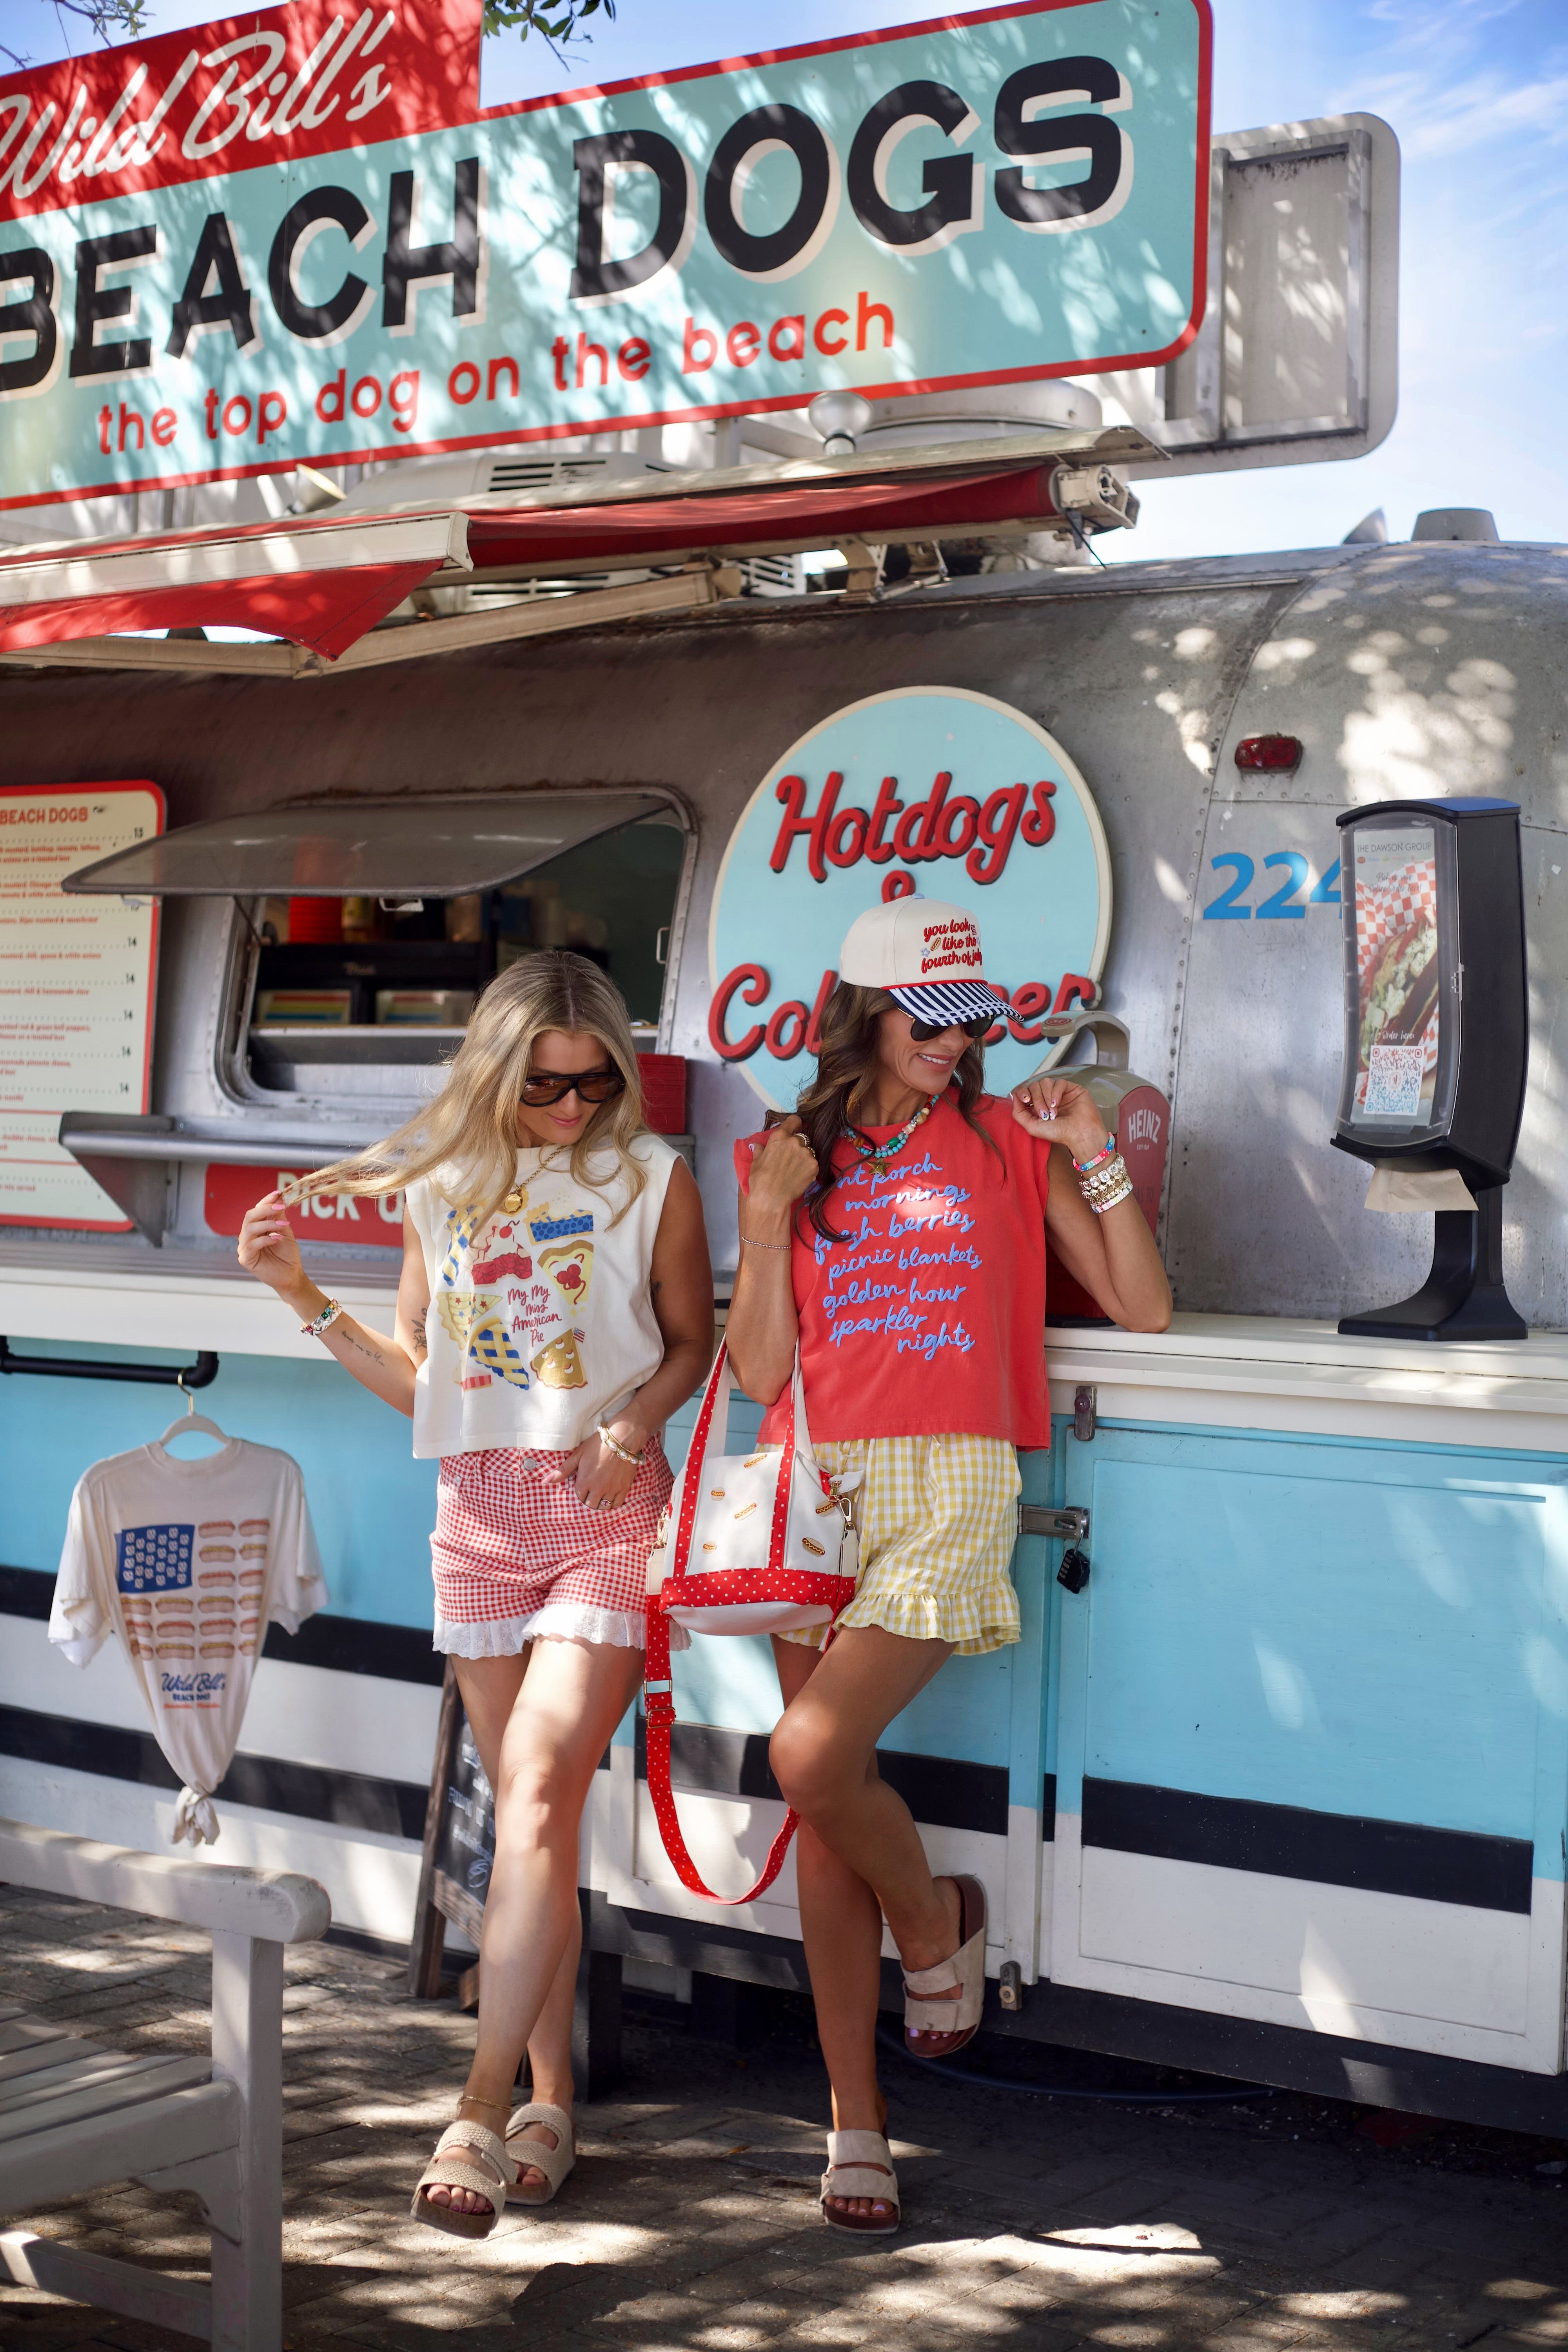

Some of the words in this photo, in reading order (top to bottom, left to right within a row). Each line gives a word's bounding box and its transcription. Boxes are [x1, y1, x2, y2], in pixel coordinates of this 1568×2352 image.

[0, 50, 199, 200] Wild
[181, 7, 396, 161] Bill's
[0, 157, 483, 395] BEACH
[569, 56, 1127, 304] DOGS
[99, 401, 178, 456] the
[204, 387, 287, 446] top
[315, 368, 421, 434] dog
[448, 356, 520, 405] on
[552, 332, 652, 392] the
[681, 291, 895, 375] beach
[0, 808, 45, 825] BEACH
[49, 806, 88, 822] DOGS
[769, 770, 1057, 886] Hotdogs
[1357, 844, 1369, 853] THE
[1371, 843, 1403, 852] DAWSON
[1405, 842, 1432, 851] GROUP
[1376, 872, 1389, 882] Pick
[1389, 884, 1405, 893] Order
[923, 924, 949, 942] you
[949, 918, 971, 933] look
[942, 935, 964, 951] like
[965, 933, 976, 947] the
[921, 950, 961, 974] fourth
[962, 950, 971, 966] of
[708, 963, 838, 1060] Col
[1382, 1030, 1399, 1040] Order
[1400, 1030, 1414, 1040] here:
[1128, 1109, 1161, 1144] HEINZ
[870, 1152, 943, 1195] porch
[845, 1184, 971, 1212] mornings
[814, 1216, 883, 1265] fresh
[888, 1210, 976, 1238] berries
[829, 1248, 895, 1290] picnic
[898, 1242, 983, 1270] blankets
[508, 1288, 529, 1306] My
[532, 1285, 551, 1303] My
[823, 1278, 906, 1319] golden
[909, 1278, 967, 1303] hour
[511, 1313, 562, 1334] American
[530, 1328, 544, 1348] Pie
[829, 1304, 928, 1347] sparkler
[897, 1322, 976, 1361] nights
